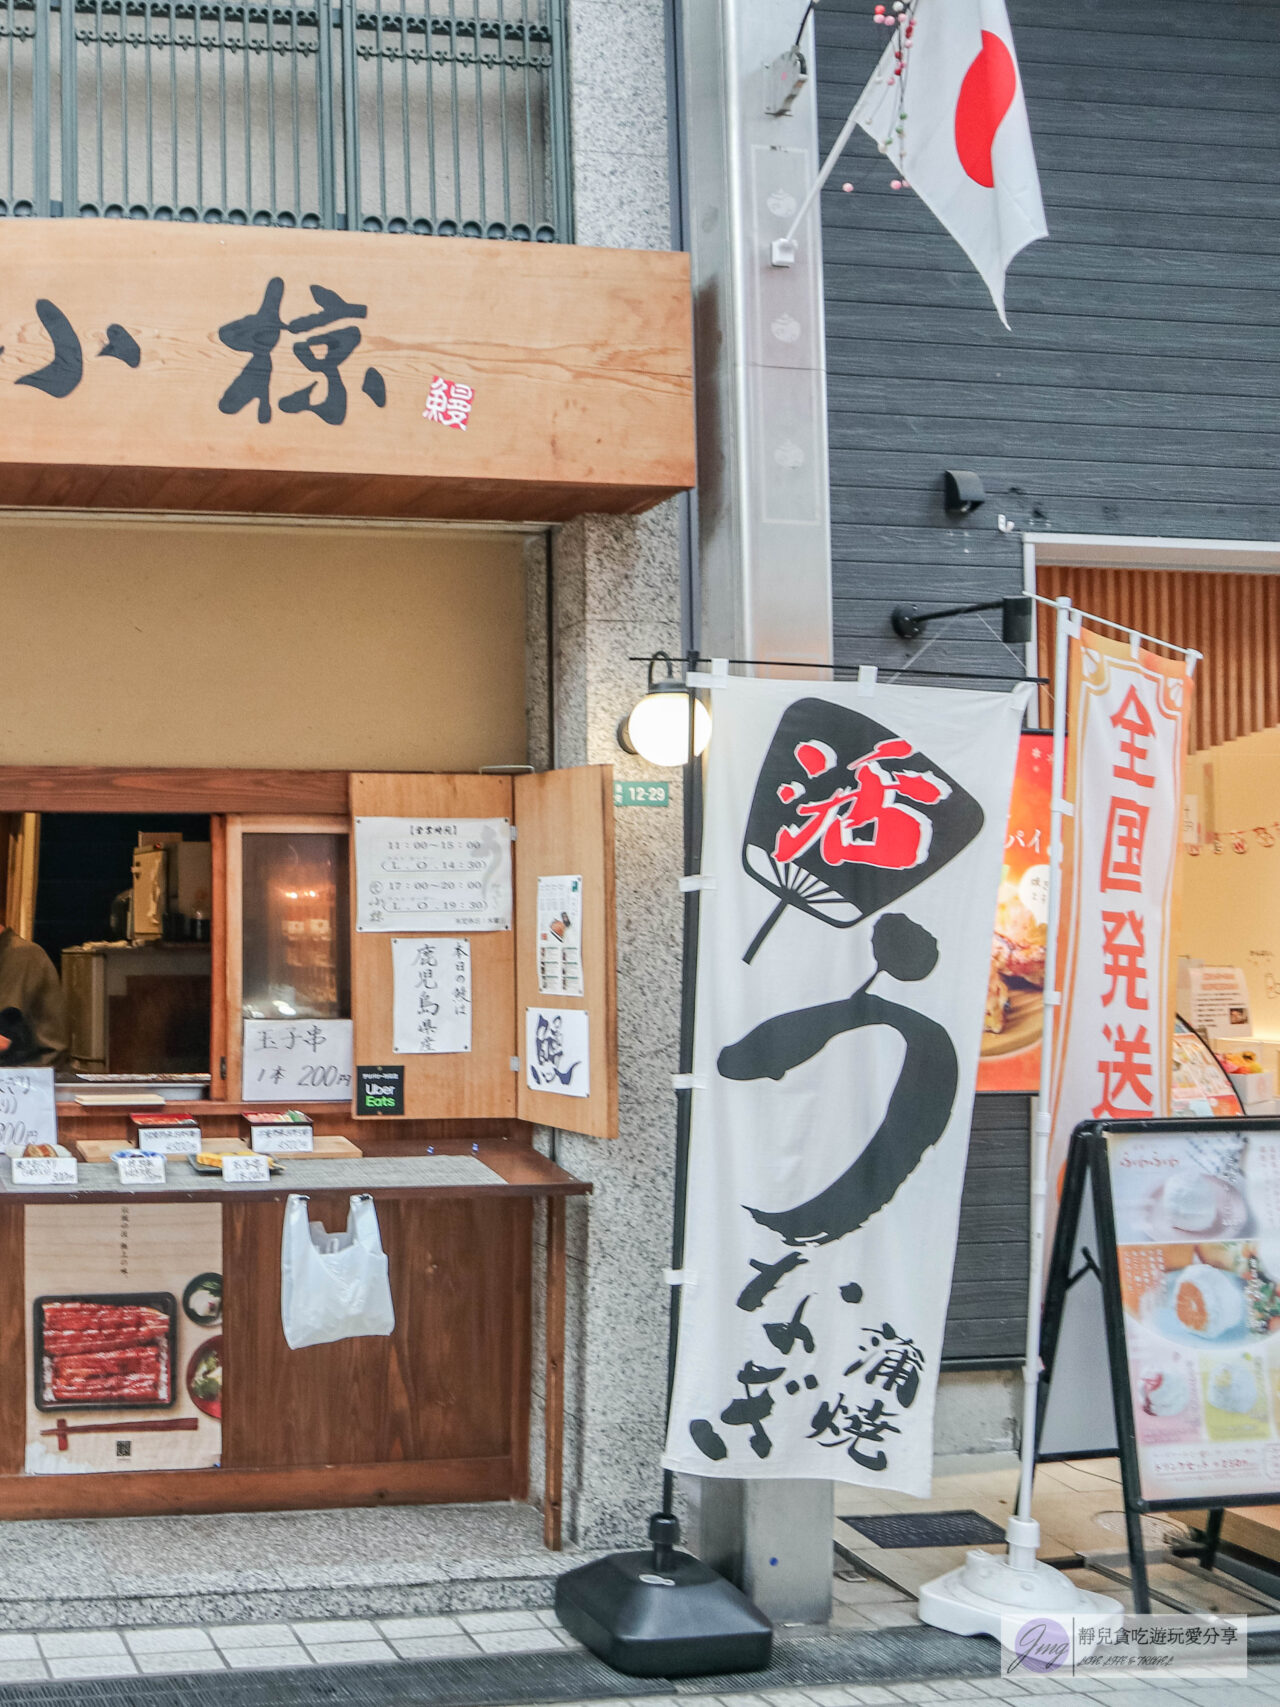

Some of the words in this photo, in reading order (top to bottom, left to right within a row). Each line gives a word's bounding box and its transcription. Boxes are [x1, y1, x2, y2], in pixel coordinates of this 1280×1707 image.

[628, 786, 666, 801] 12-29
[770, 737, 952, 869] 活
[1091, 683, 1157, 1118] 全国発送
[253, 1025, 327, 1053] 玉子串
[297, 1065, 352, 1087] 200円
[365, 1083, 396, 1096] Uber
[365, 1096, 396, 1107] Eats
[689, 912, 959, 1461] うなぎ
[805, 1321, 925, 1471] 蒲焼
